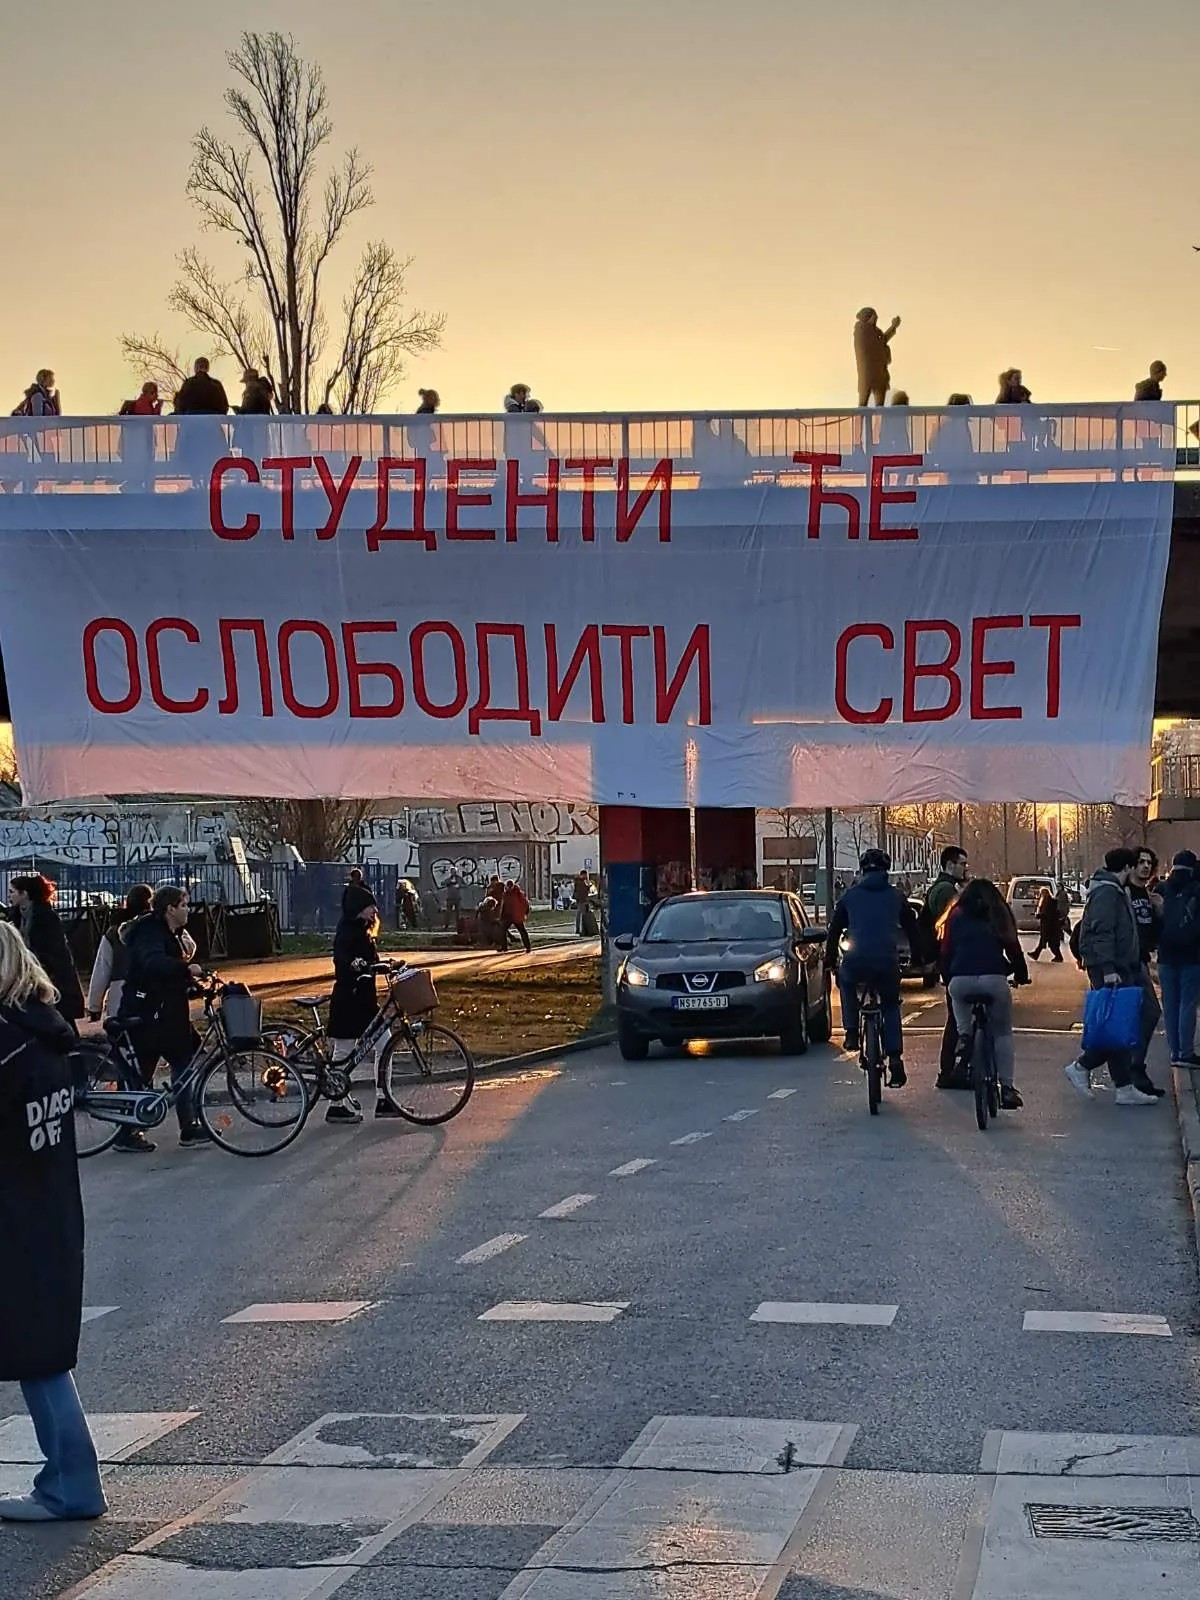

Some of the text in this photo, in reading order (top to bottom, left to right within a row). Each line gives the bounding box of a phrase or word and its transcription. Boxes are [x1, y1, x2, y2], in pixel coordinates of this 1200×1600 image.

[209, 451, 923, 552] СТУДЕНТИ ЋЕ
[83, 615, 1081, 736] ОСЛОБОДИТИ СВЕТ
